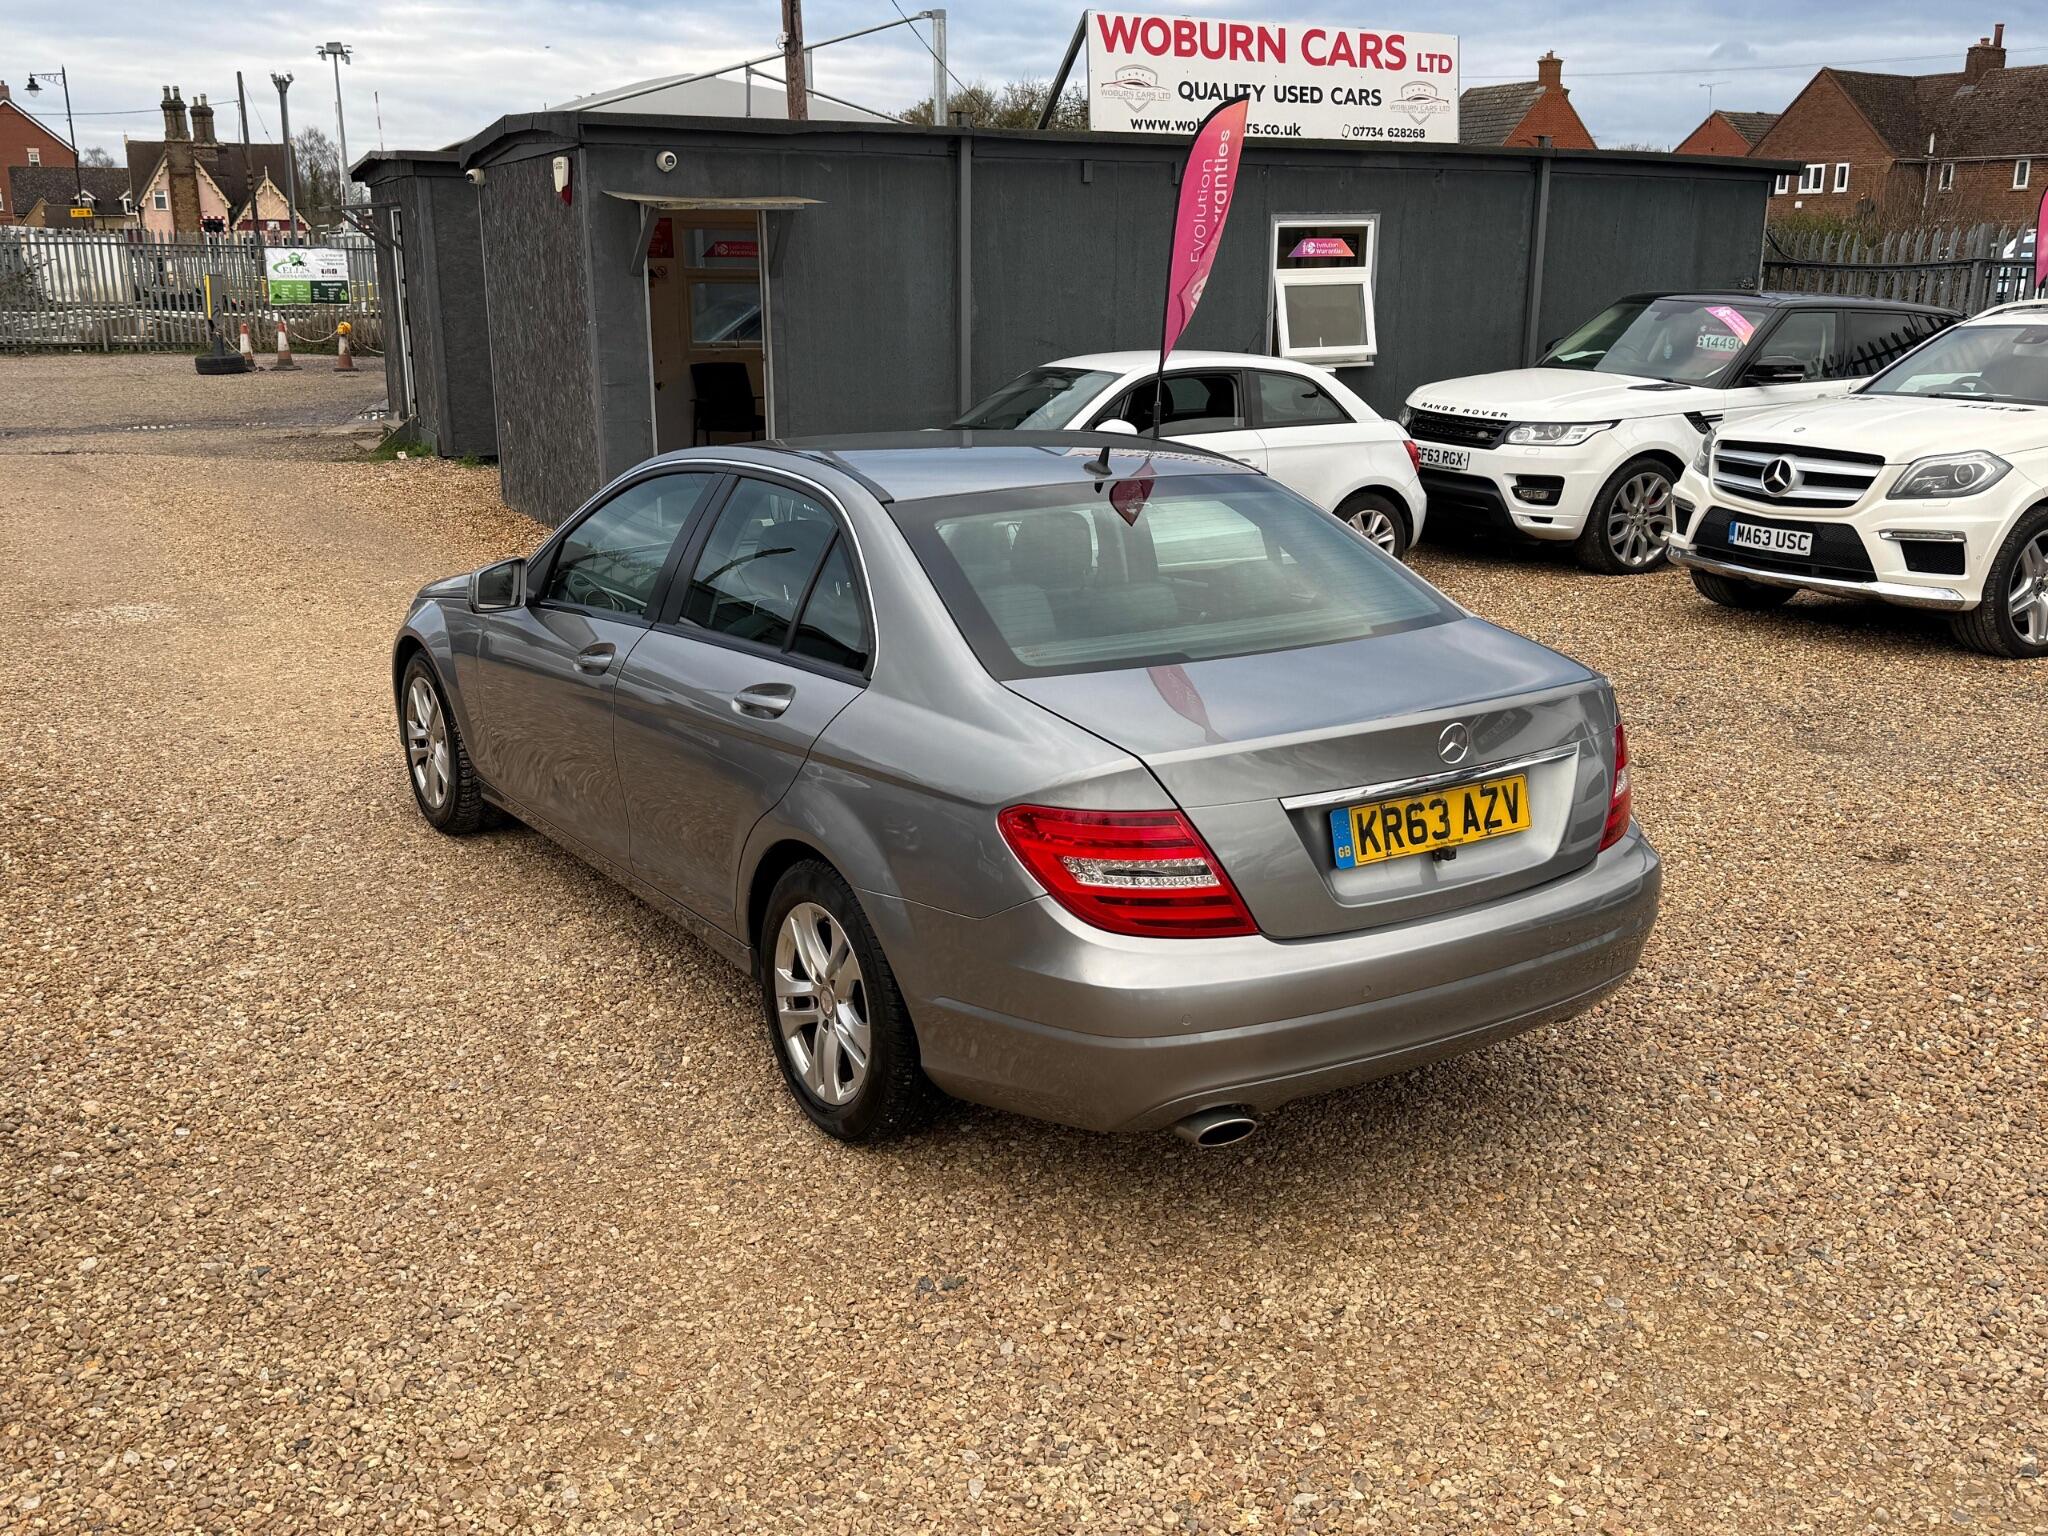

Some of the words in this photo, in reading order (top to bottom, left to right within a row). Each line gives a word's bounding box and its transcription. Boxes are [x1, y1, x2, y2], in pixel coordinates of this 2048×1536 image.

[1097, 14, 1286, 64] WOBURN
[1300, 28, 1407, 71] CARS
[1416, 53, 1453, 74] LTD
[1178, 81, 1266, 102] QUALITY
[1274, 85, 1323, 104] USED
[1330, 87, 1382, 106] CARS
[1131, 118, 1301, 137] www.wors.co.uk
[1352, 126, 1384, 138] 07734
[1387, 127, 1426, 139] 628268
[1213, 129, 1231, 223] ranties
[1190, 159, 1213, 263] Evolution
[1420, 402, 1457, 412] RANGE
[1462, 408, 1509, 418] ROVER
[1442, 450, 1464, 466] RGX
[1736, 524, 1772, 547] MA63
[1775, 530, 1810, 551] USC
[1356, 798, 1451, 856] KR63
[1463, 782, 1519, 834] AZV
[1338, 845, 1350, 858] GB
